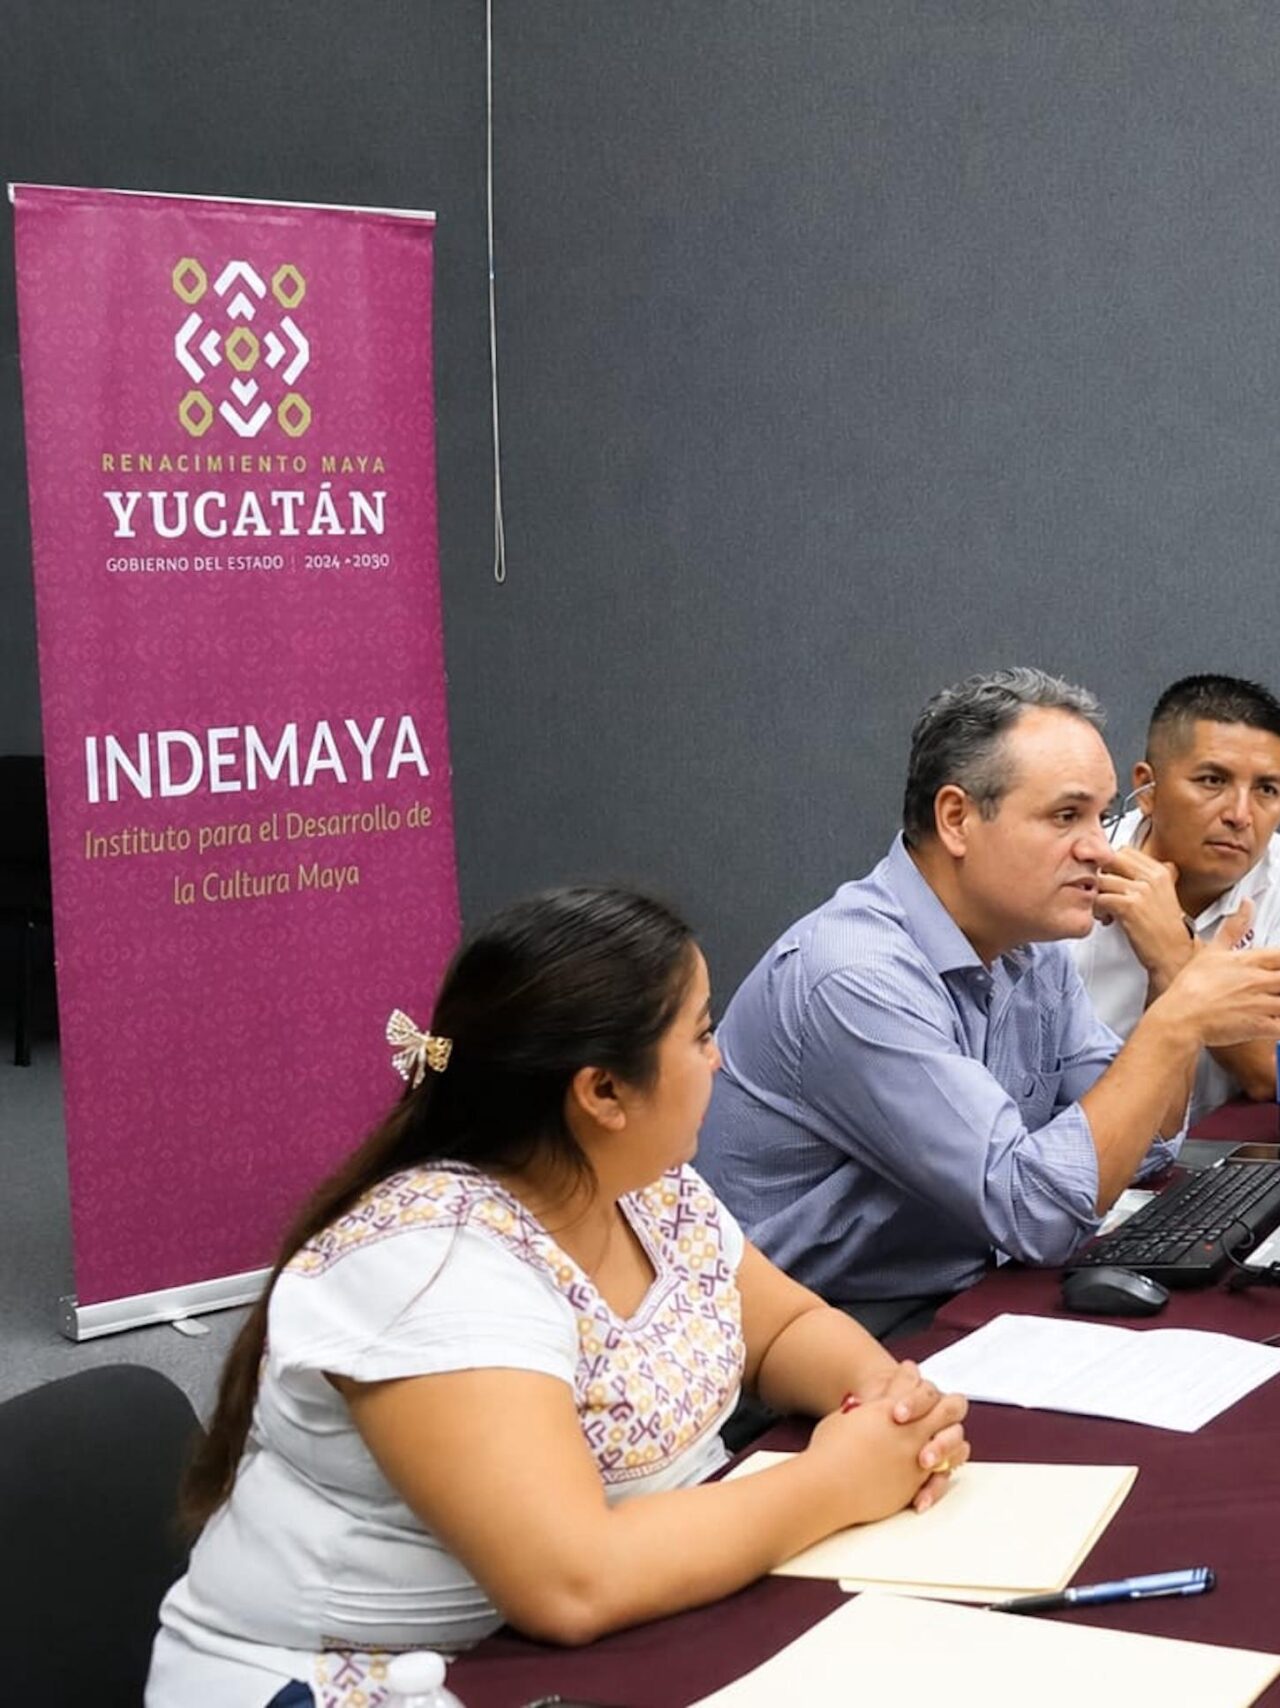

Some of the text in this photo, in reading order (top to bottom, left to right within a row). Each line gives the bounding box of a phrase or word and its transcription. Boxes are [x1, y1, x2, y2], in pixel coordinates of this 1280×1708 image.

[102, 453, 386, 474] RENACIMIENTO MAYA
[103, 481, 387, 538] YUCATÁN
[106, 557, 189, 572] GOBIERNO
[194, 556, 222, 571] DEL
[228, 555, 284, 571] ESTADO
[304, 554, 340, 570] 2024
[84, 715, 431, 804] INDEMAYA
[84, 800, 432, 860] Instituto para el Desarrollo de
[173, 862, 360, 905] la Cultura Maya
